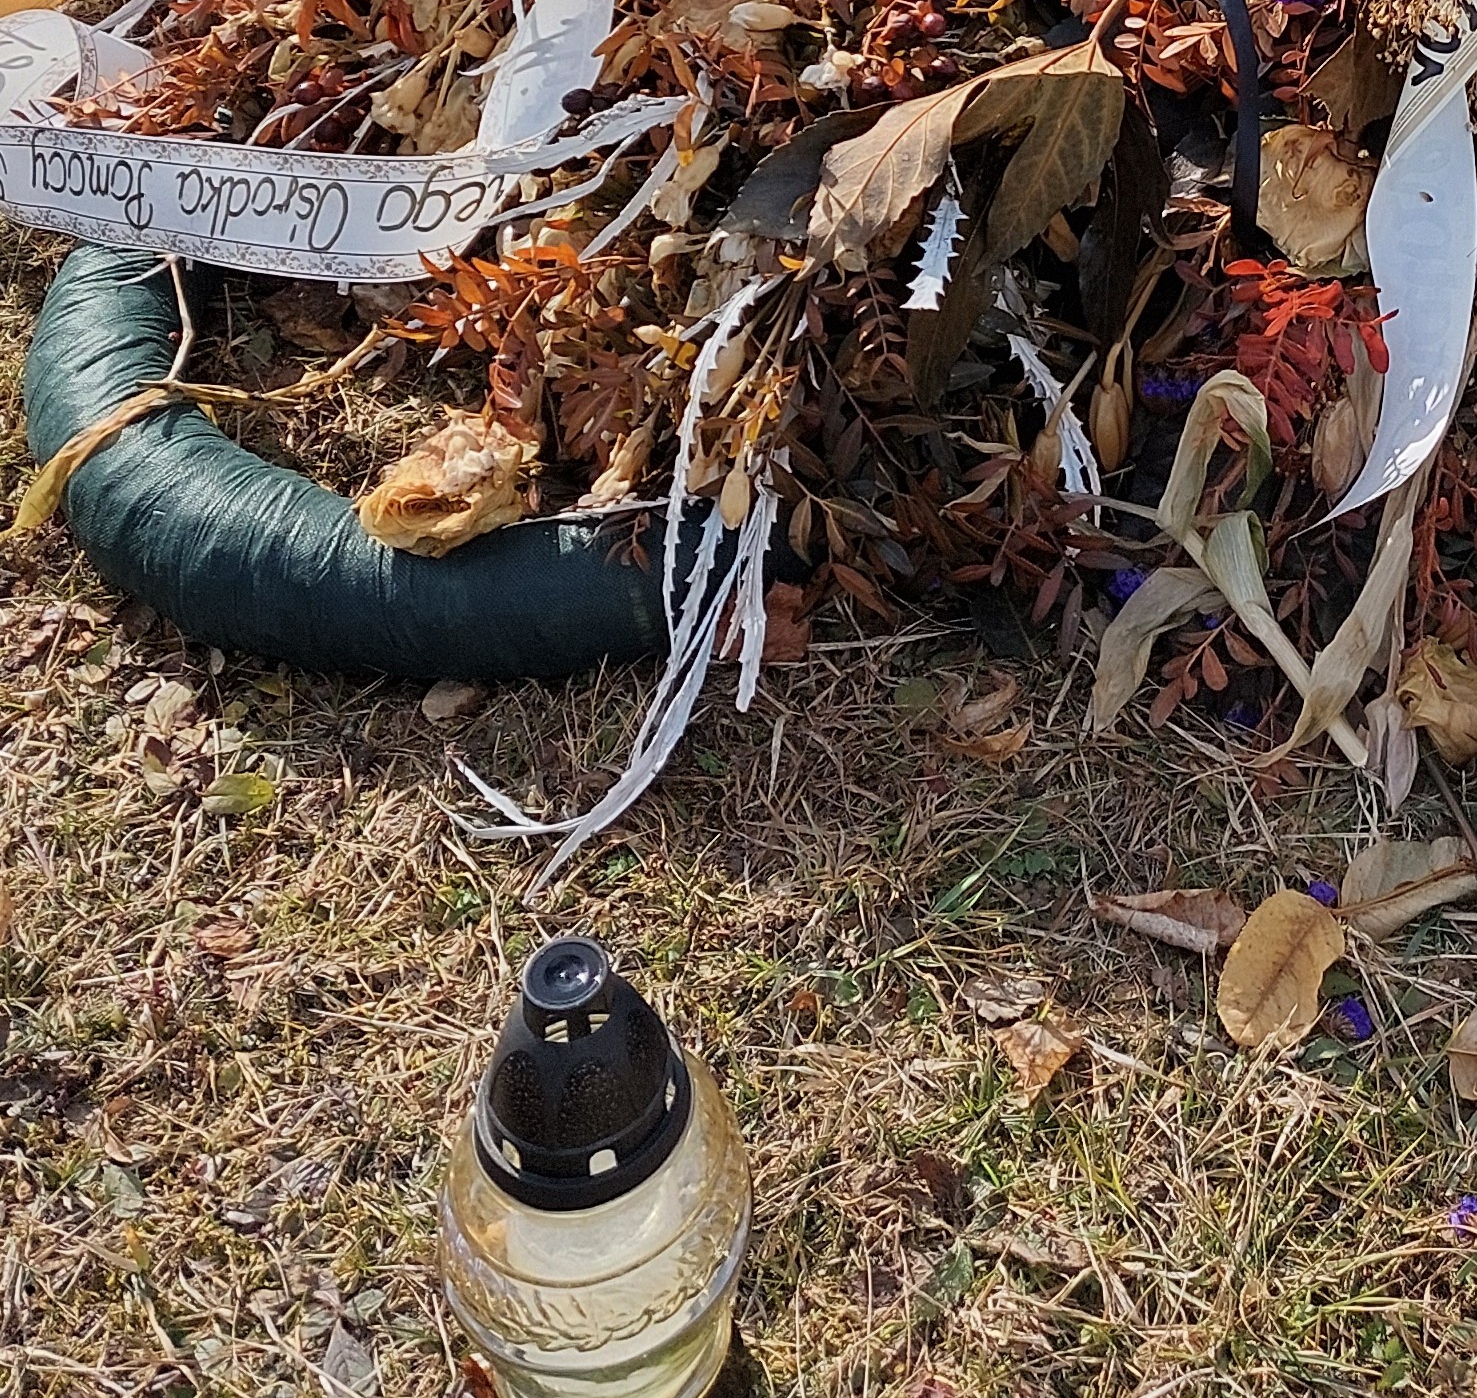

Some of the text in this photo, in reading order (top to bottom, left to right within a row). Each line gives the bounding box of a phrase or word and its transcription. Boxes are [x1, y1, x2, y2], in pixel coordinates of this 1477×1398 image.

[30, 130, 154, 230] Pomocy
[179, 168, 350, 252] Ośrodka
[376, 165, 505, 231] iego
